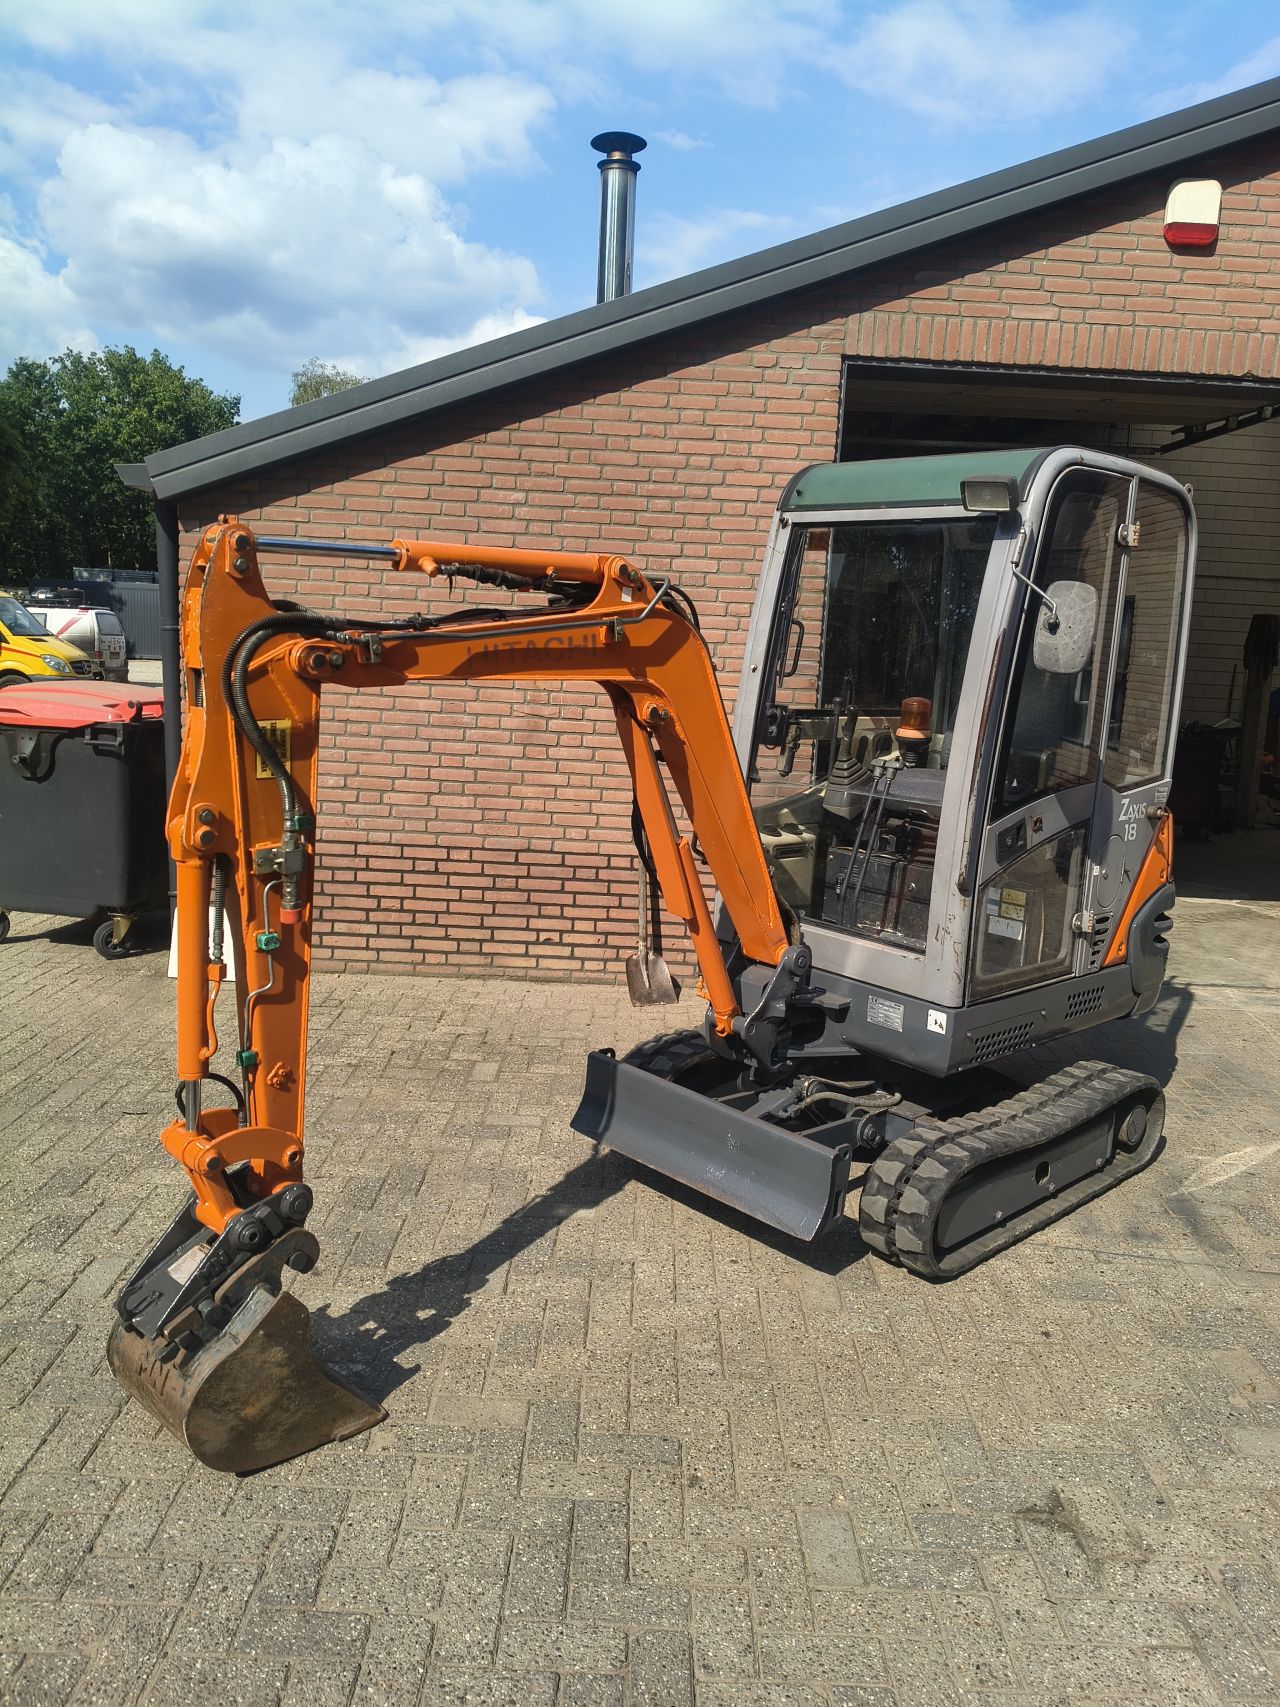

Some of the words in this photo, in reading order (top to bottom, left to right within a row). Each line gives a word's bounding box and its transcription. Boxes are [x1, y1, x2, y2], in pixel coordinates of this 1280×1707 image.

[467, 634, 597, 668] HITACHI
[1118, 798, 1147, 822] ZAXIS
[1124, 823, 1137, 841] 18
